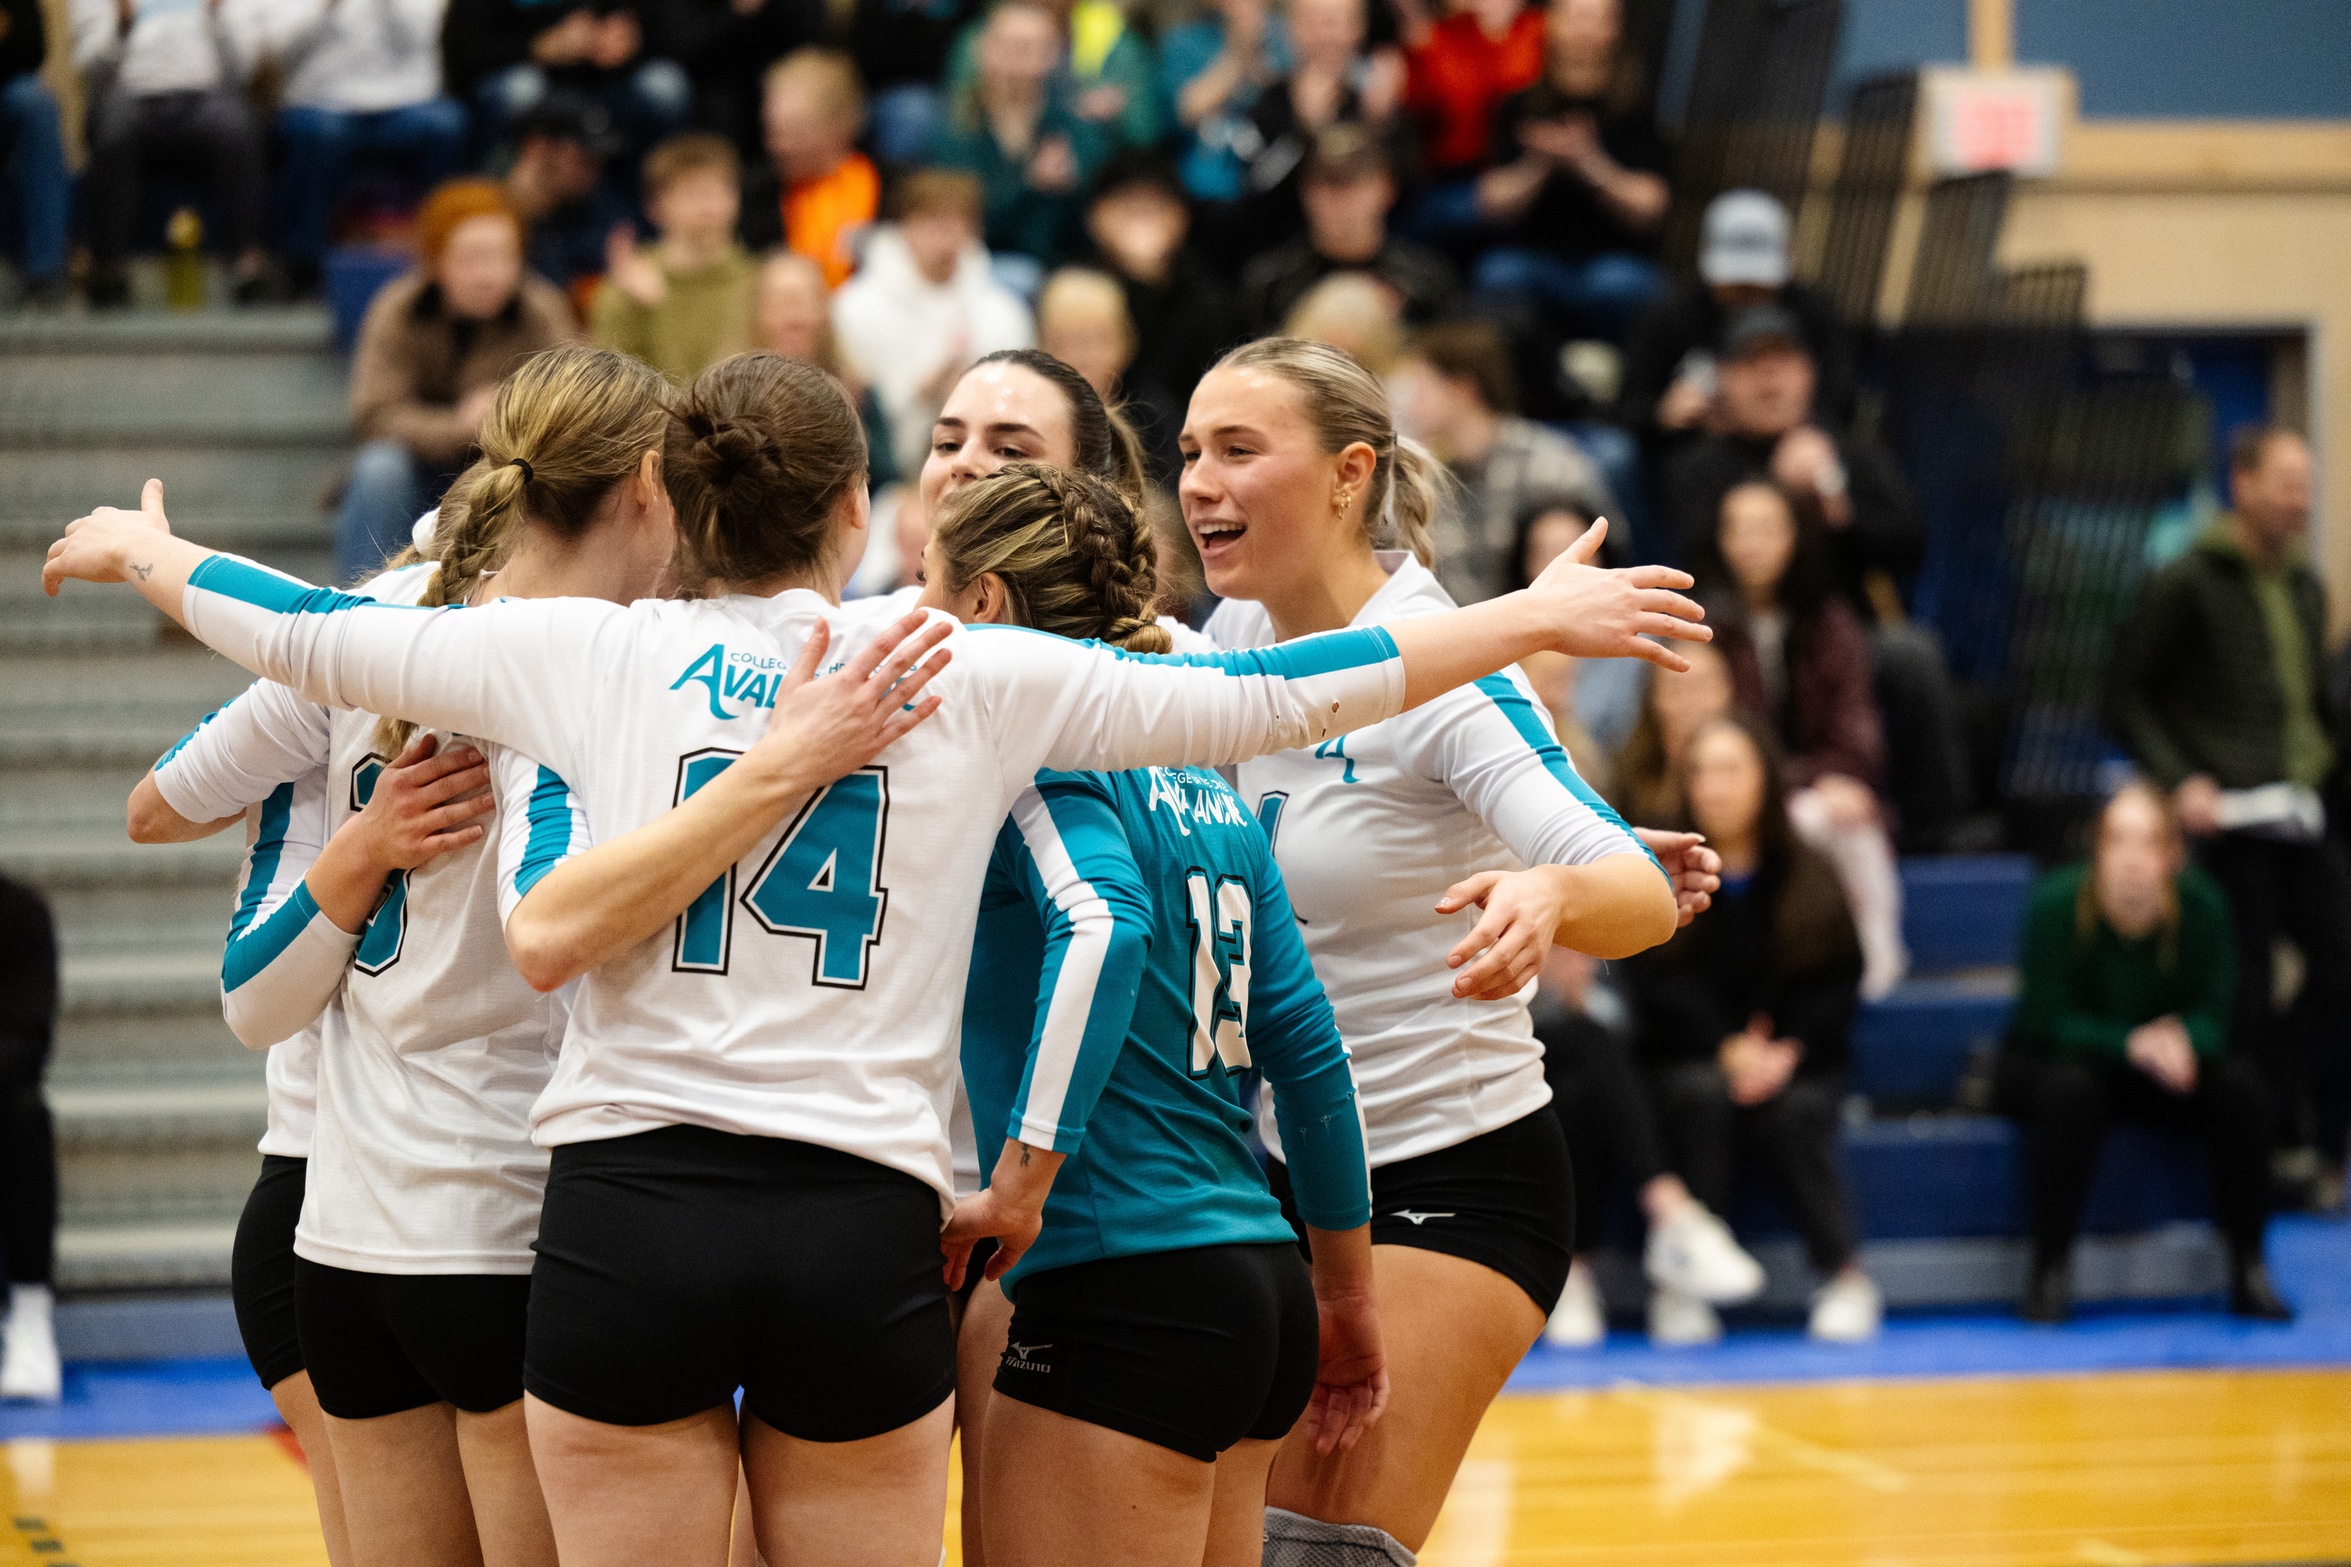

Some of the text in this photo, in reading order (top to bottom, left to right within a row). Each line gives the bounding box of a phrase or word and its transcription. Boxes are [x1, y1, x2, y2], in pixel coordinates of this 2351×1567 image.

[730, 652, 790, 672] COLLEG
[671, 746, 891, 991] 14
[1185, 865, 1254, 1081] 13
